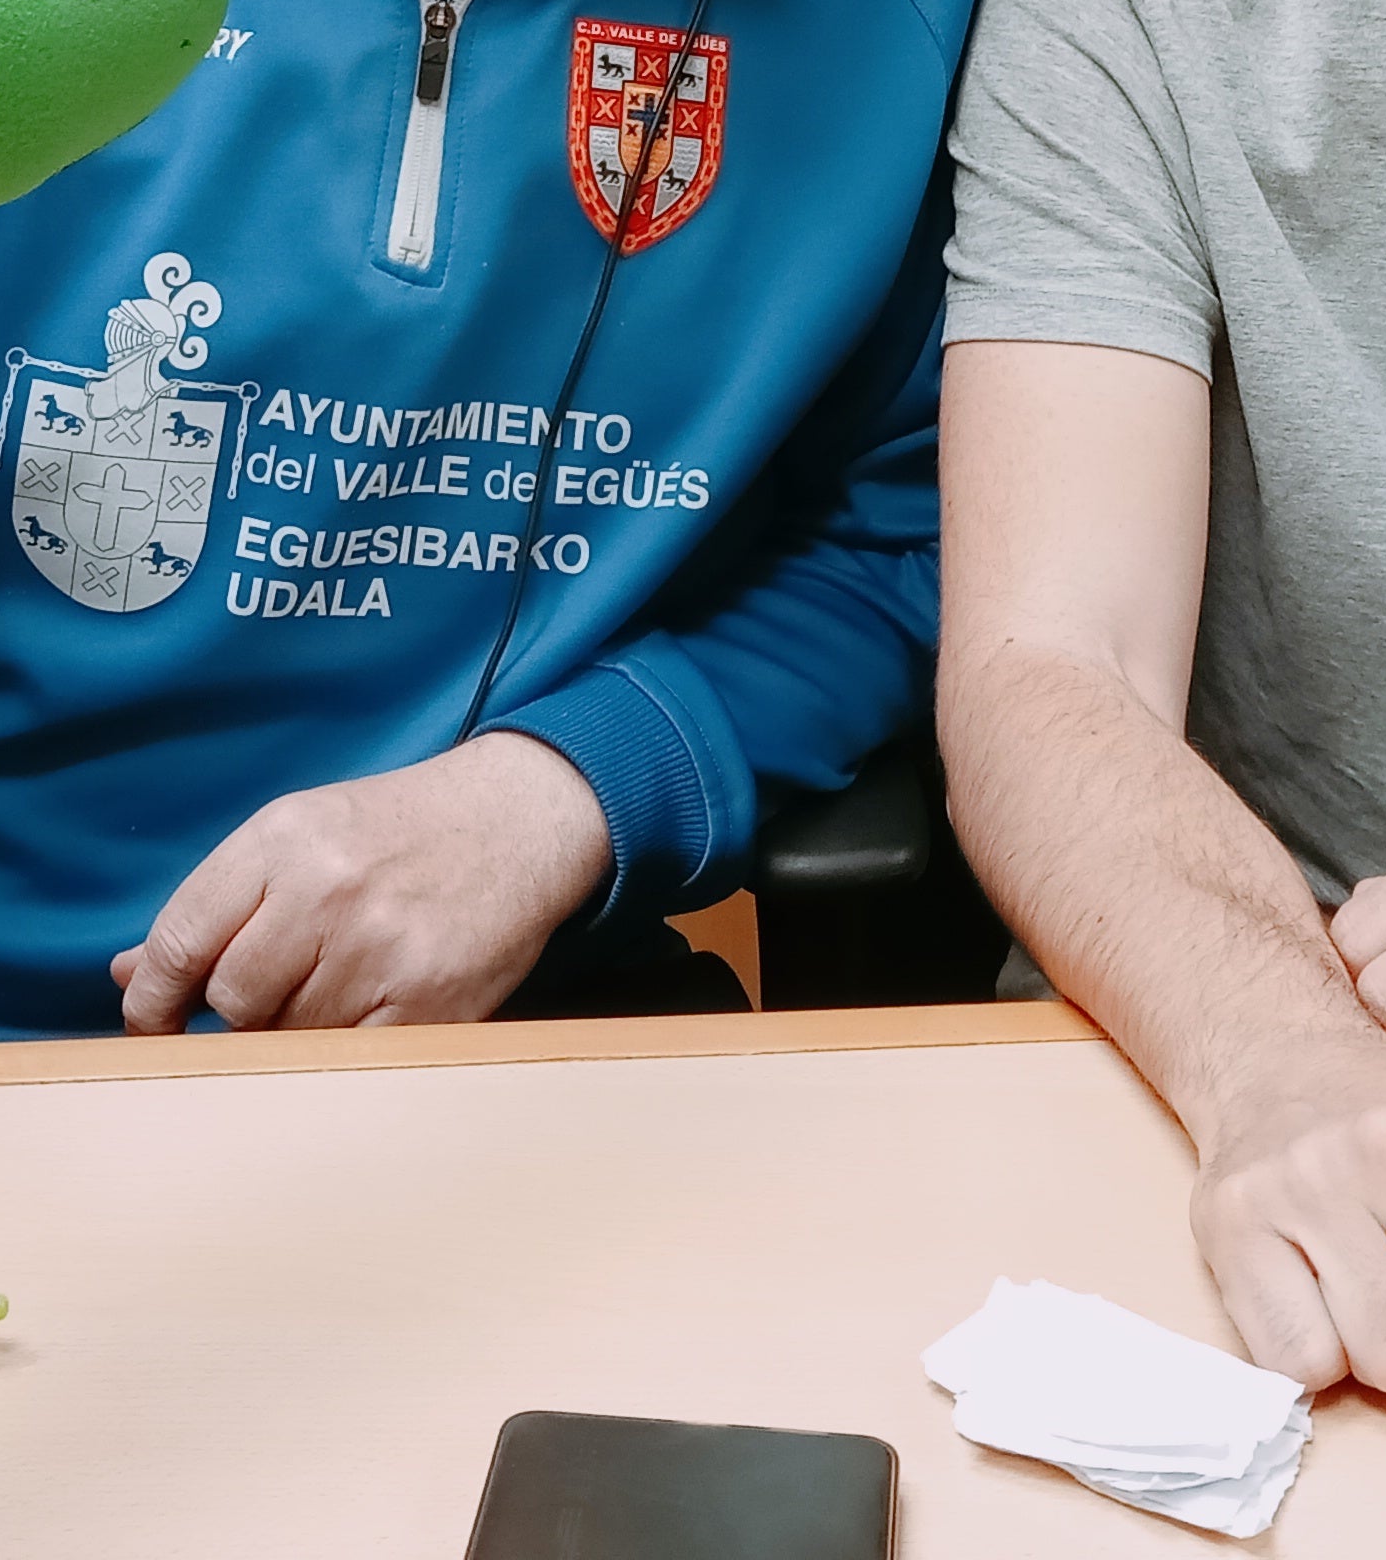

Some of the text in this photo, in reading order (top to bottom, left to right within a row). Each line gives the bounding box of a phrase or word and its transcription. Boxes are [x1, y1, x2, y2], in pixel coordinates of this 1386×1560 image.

[577, 22, 605, 36] C.D.
[609, 26, 654, 42] VALLE
[659, 33, 677, 45] DE
[258, 389, 632, 454] AYUNTAMIENTO
[245, 445, 710, 511] del VALLE de EGÜÉS
[234, 517, 590, 575] EGUESIBARKO
[225, 572, 392, 618] UDALA
